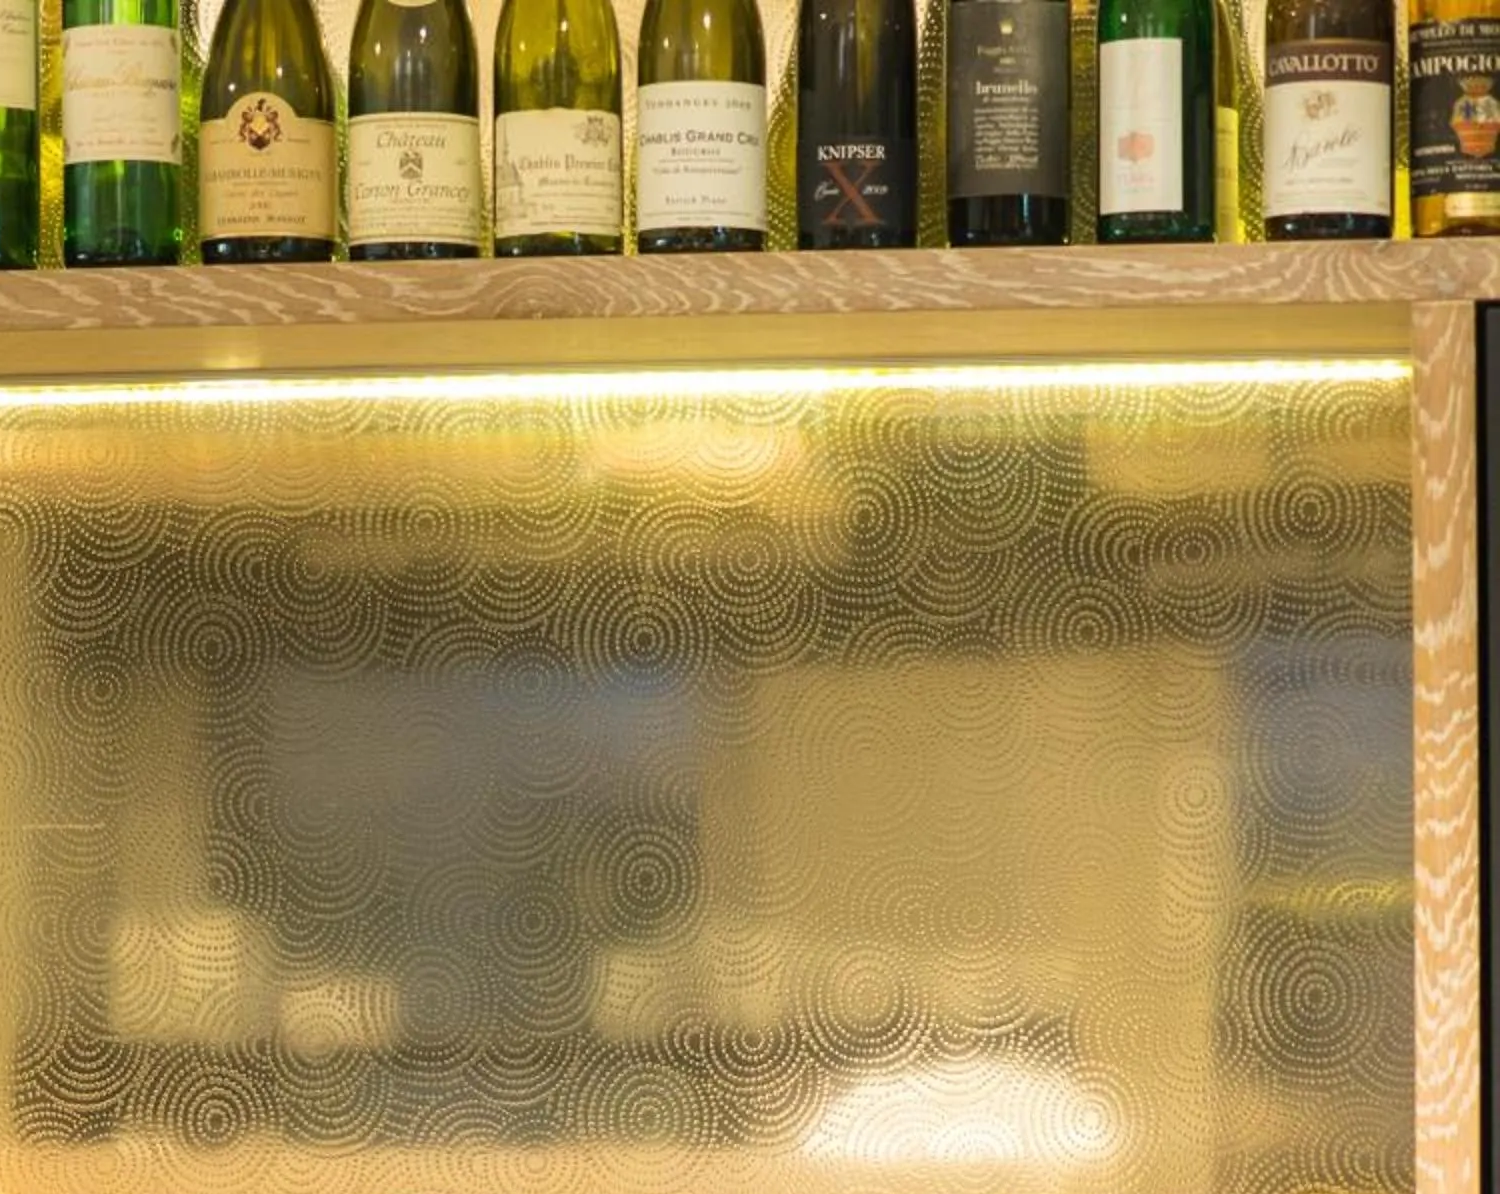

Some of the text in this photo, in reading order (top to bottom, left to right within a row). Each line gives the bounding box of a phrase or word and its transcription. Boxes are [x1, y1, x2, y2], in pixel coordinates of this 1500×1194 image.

[1268, 53, 1381, 77] CAVALLOTTO
[1411, 53, 1500, 78] AMPOGIO
[975, 79, 1039, 96] brunello
[685, 129, 734, 144] GRAND
[817, 145, 886, 161] KNIPSER
[818, 160, 887, 226] X
